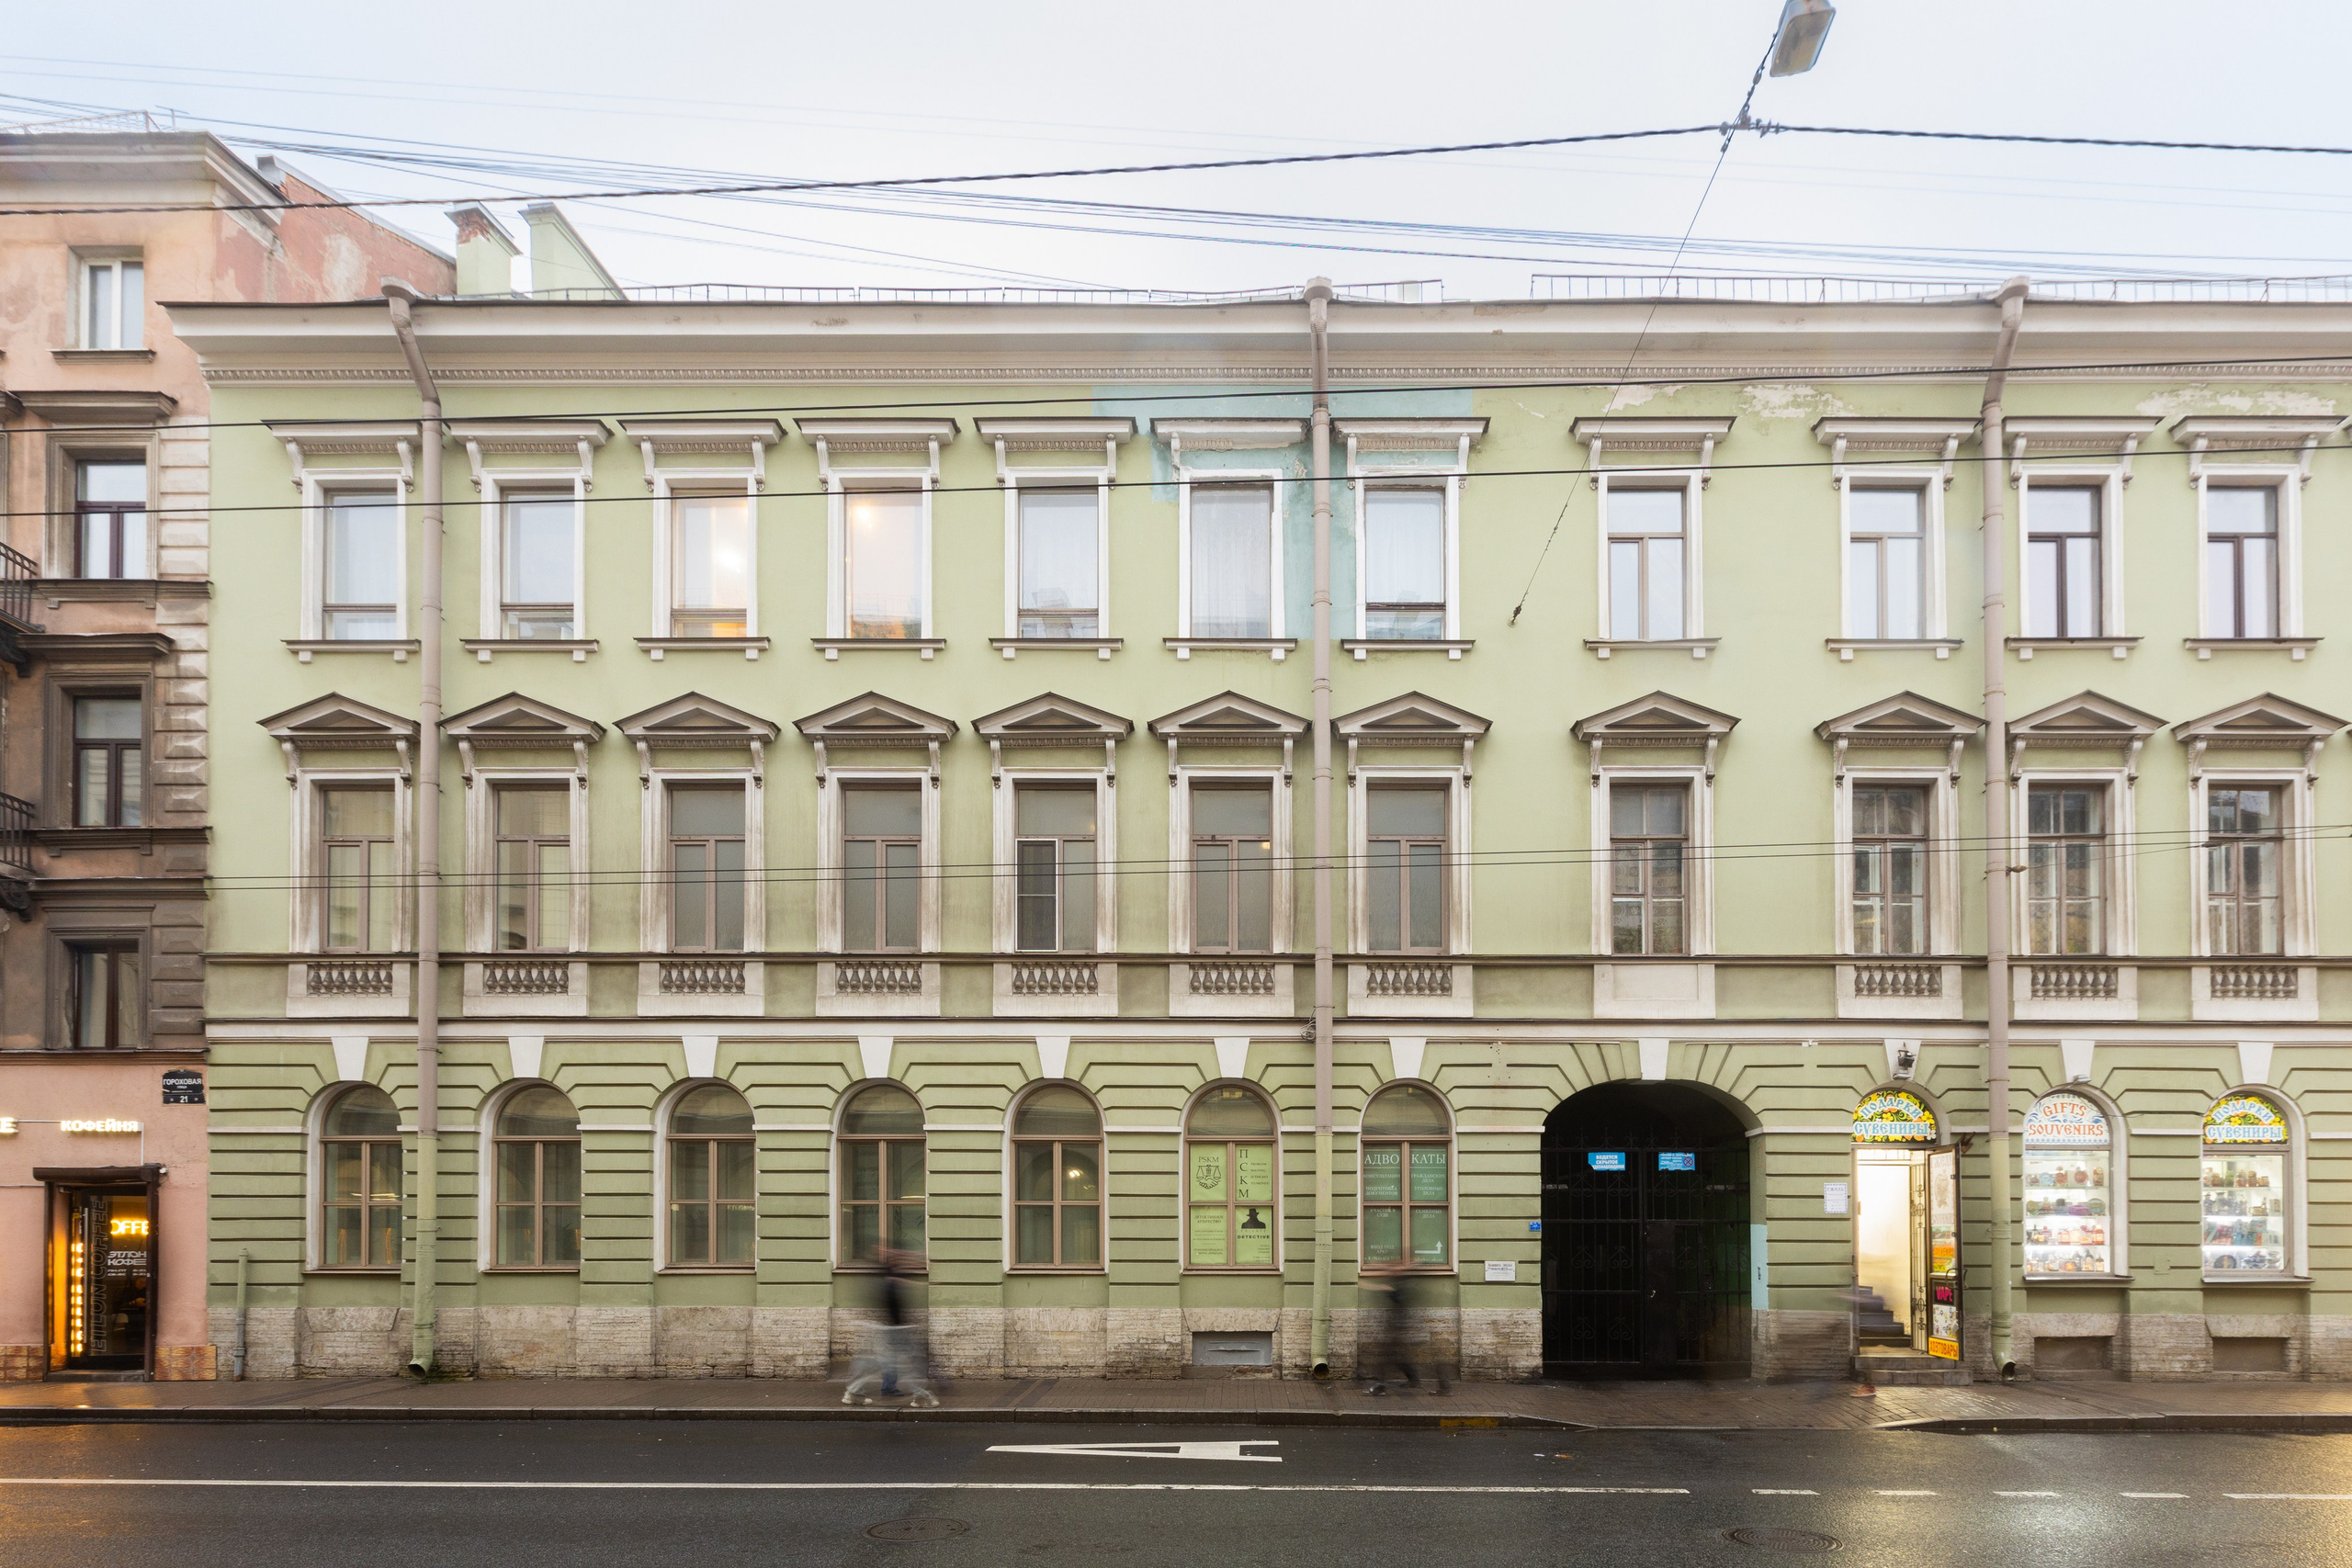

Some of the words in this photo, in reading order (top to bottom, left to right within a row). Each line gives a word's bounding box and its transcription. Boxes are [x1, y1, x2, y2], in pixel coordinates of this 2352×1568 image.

[179, 1095, 188, 1103] 21
[1859, 1096, 1924, 1120] ПОДАРКИ
[2042, 1102, 2086, 1118] GIFTS
[2211, 1100, 2276, 1123] ПОДАРКИ
[60, 1118, 140, 1132] КОФЕЙНЯ
[1853, 1122, 1929, 1138] СУВЕНИРЫ
[2028, 1122, 2105, 1137] SOUVENIRS
[2206, 1125, 2284, 1142] СУВЕНИРЫ
[1936, 1287, 1952, 1302] VAPE
